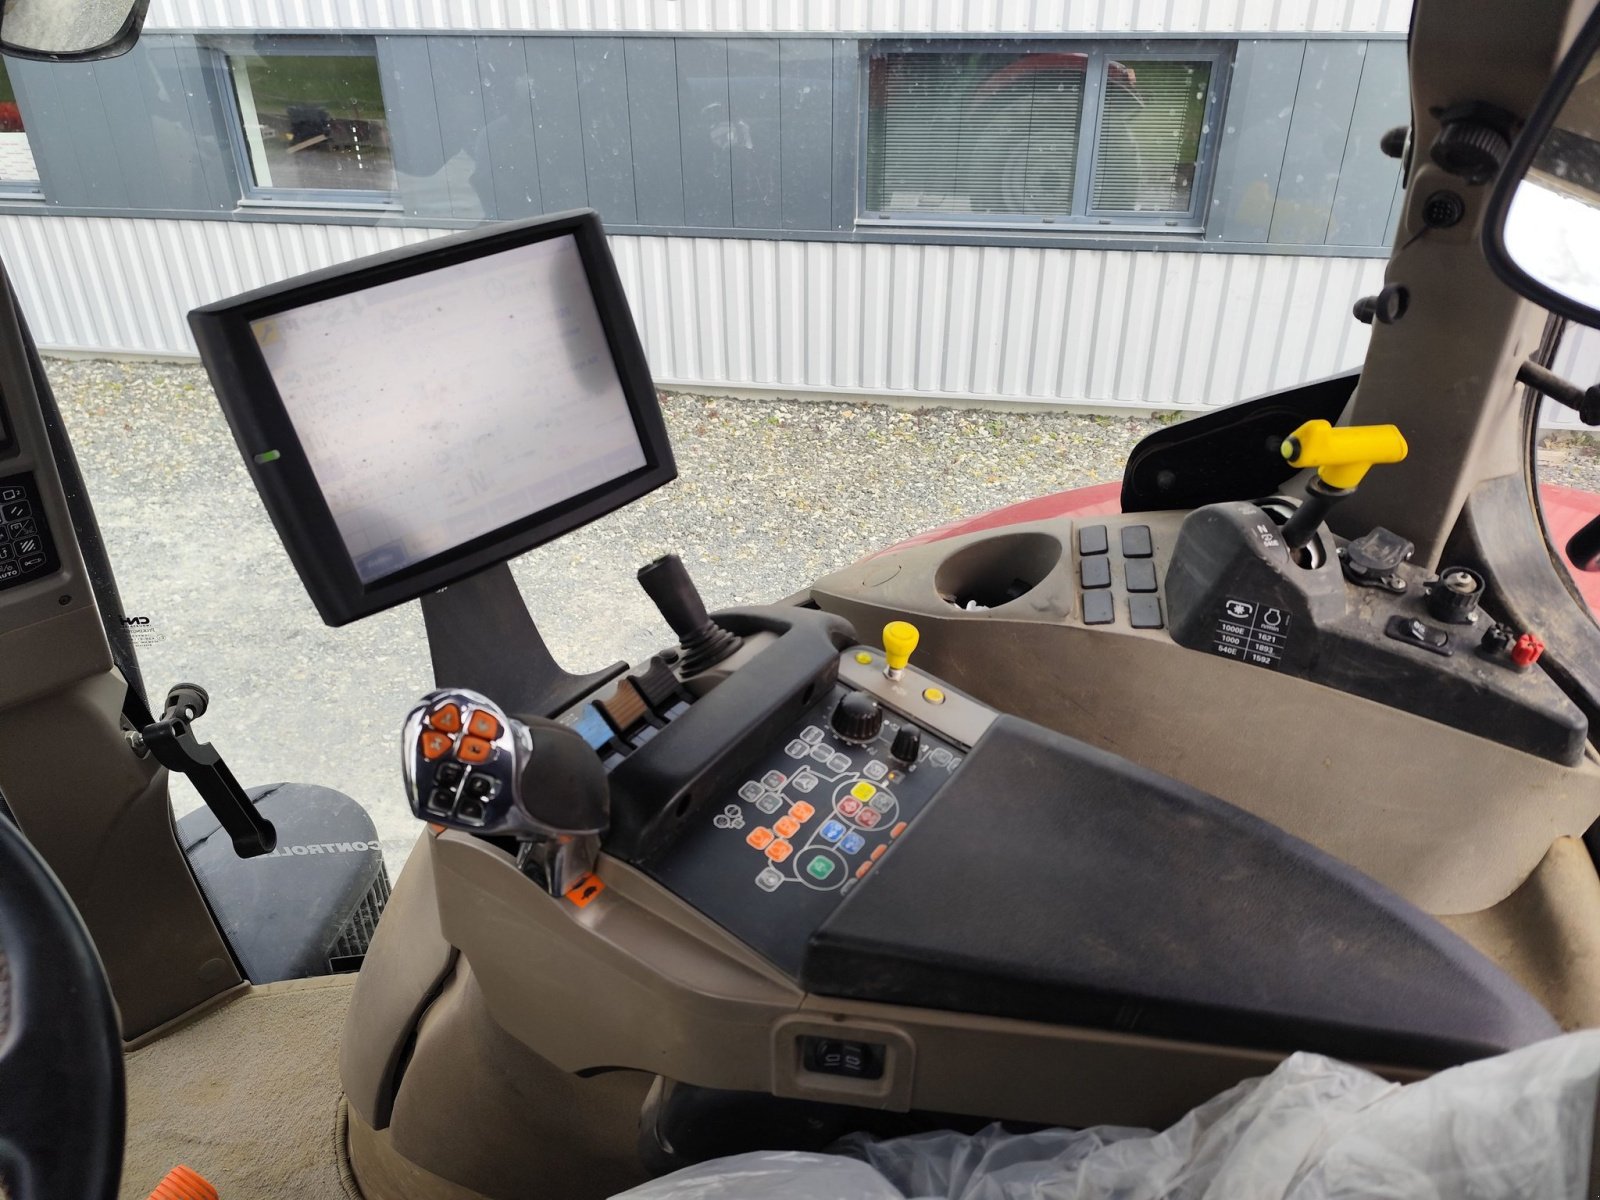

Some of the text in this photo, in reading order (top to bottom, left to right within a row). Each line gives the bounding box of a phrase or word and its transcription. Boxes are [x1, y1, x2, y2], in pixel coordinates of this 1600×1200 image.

[1222, 624, 1276, 643] 1000E 1621
[1222, 635, 1274, 653] 1000 1893
[1218, 645, 1271, 664] 540E 1592
